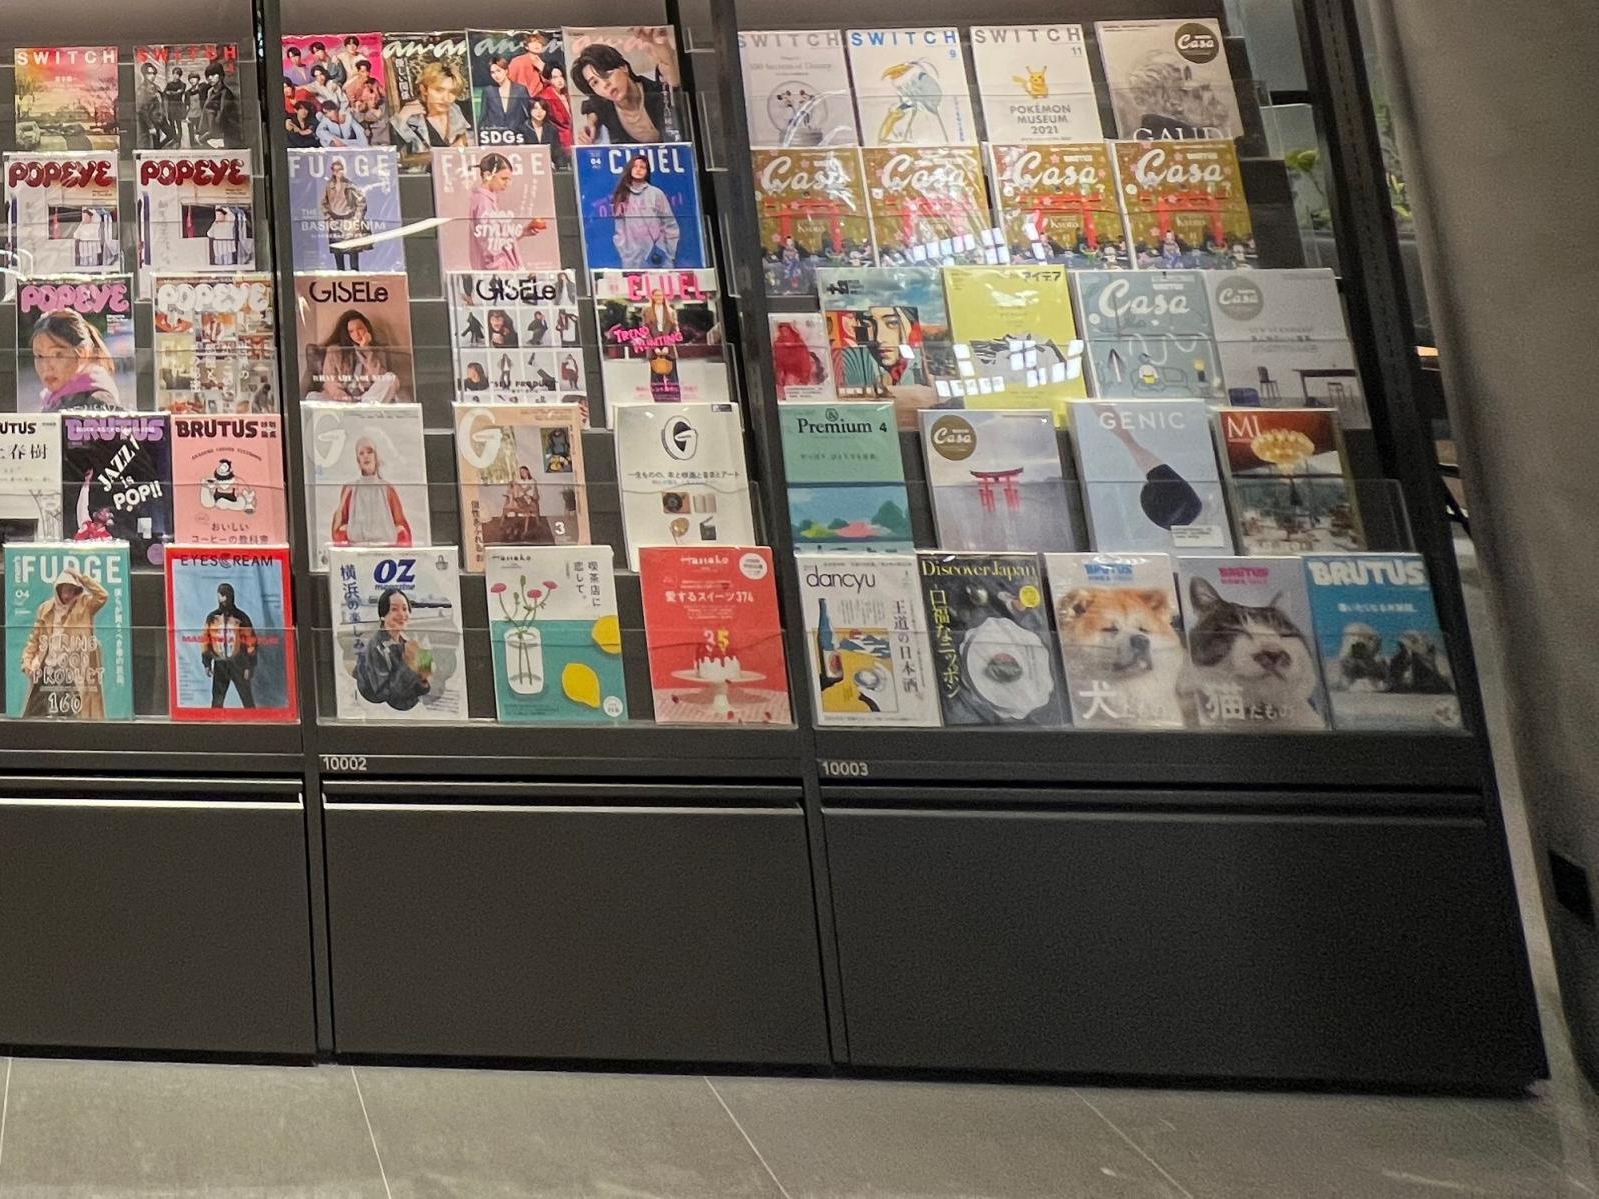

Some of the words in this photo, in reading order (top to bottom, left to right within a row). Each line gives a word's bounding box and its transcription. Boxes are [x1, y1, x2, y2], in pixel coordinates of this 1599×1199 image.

[739, 33, 840, 48] SWITCH
[851, 31, 957, 46] SWITCH
[975, 28, 1082, 44] SWITCH
[17, 50, 116, 65] SWITCH
[1017, 115, 1069, 125] MUSEUM
[480, 130, 525, 144] SDGs
[1031, 125, 1058, 135] 2021
[8, 160, 114, 188] POPEYE
[141, 158, 247, 187] POPEYE
[1013, 150, 1098, 188] Casa
[1135, 148, 1223, 186] Casa
[474, 223, 523, 238] STYLING
[21, 284, 130, 313] POPEYE
[157, 283, 269, 312] POPEYE
[1098, 278, 1190, 317] Casa
[65, 418, 165, 442] BRUTUS
[175, 419, 259, 438] BRUTUS
[797, 417, 873, 434] Premium
[878, 422, 888, 433] 4
[1100, 411, 1186, 431] GENIC
[933, 426, 973, 445] Casa
[211, 522, 249, 532] おいしい
[554, 521, 566, 535] 3
[22, 555, 122, 584] FUDGE
[373, 559, 417, 584] OZ
[921, 560, 989, 577] Discover
[1307, 559, 1426, 587] BRUTUS
[806, 566, 876, 594] dancyu
[48, 692, 83, 714] 160
[323, 757, 367, 771] 10002
[822, 761, 869, 777] 10003
